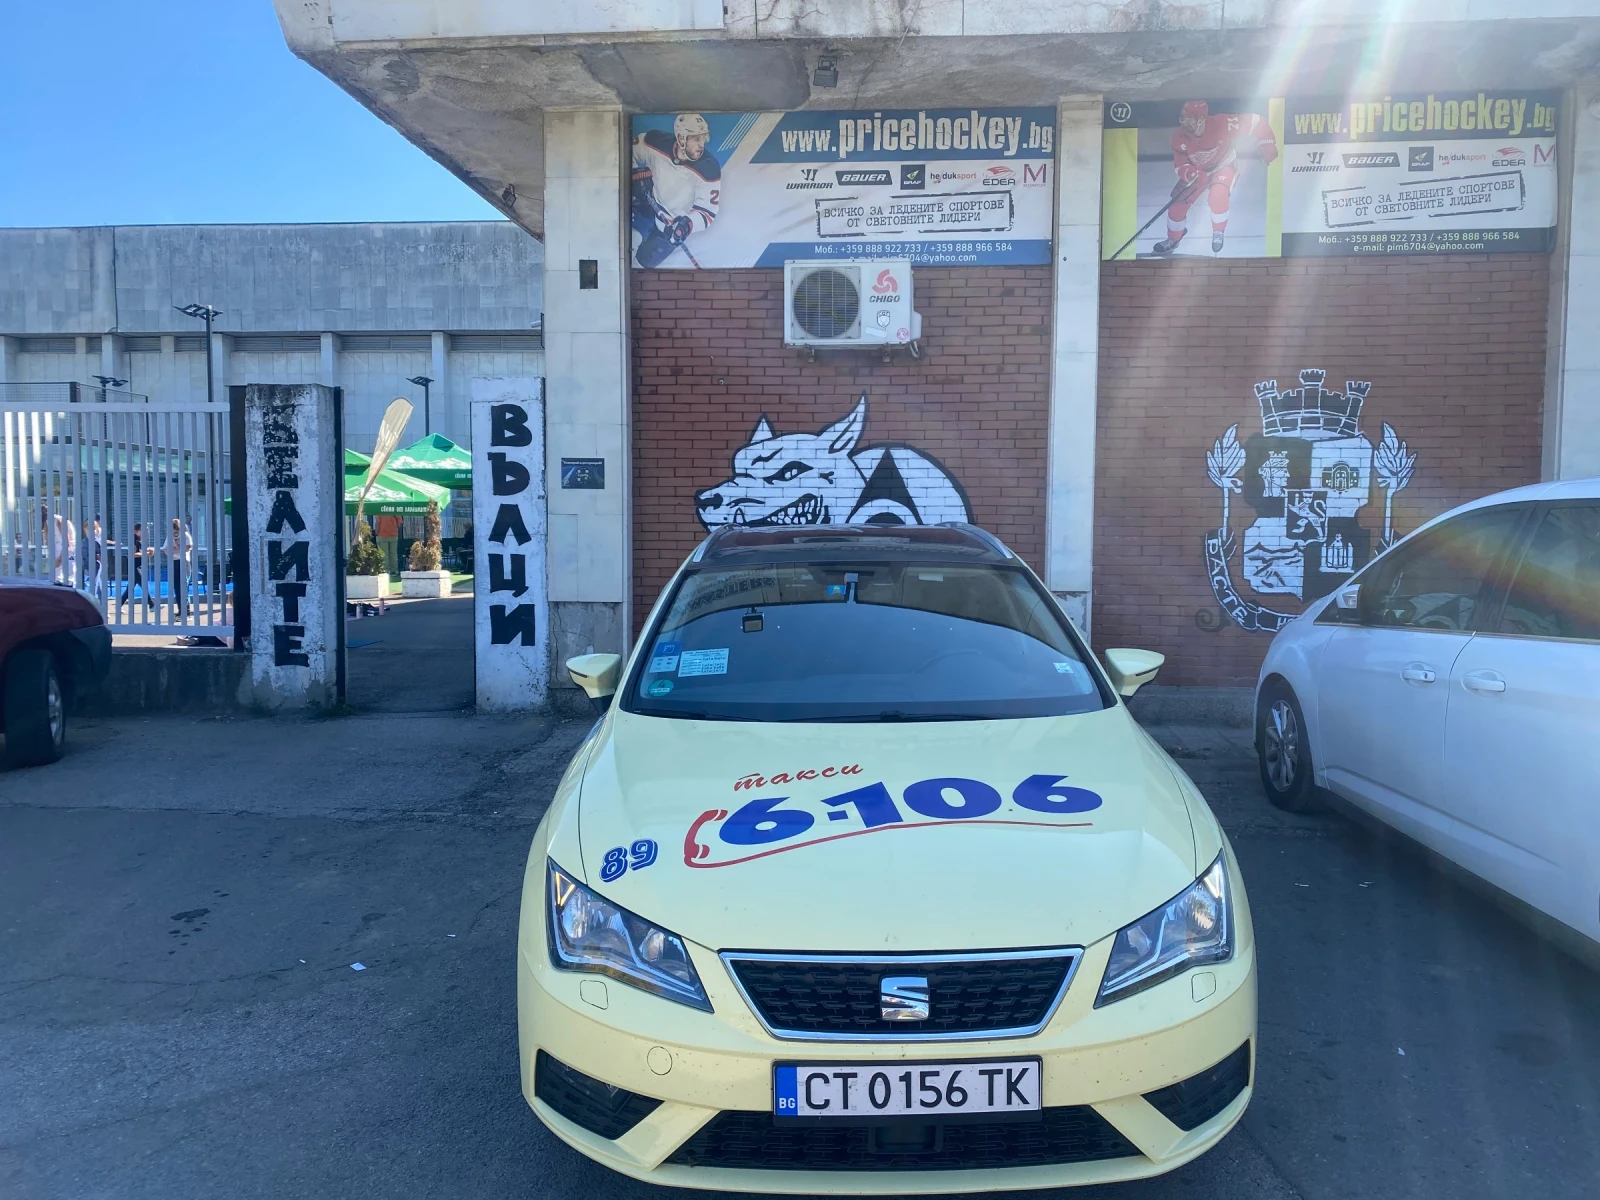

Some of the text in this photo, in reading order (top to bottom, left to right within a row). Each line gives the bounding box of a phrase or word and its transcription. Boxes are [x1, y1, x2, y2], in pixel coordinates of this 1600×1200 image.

[1294, 93, 1556, 140] www.pricehockey.bg
[782, 110, 1053, 159] www.pricehockey.bg
[1291, 165, 1340, 173] WARRIOR
[1348, 156, 1394, 165] BAUER
[786, 182, 833, 190] WARRIOR
[841, 173, 887, 182] BAUER
[1331, 179, 1515, 209] ВСИЧКО ЗА ЛЕДЕНИТЕ СПОРТОВЕ
[824, 199, 1005, 218] ВСИЧКО ЗА ЛЕДЕНИТЕ СПОРТОВЕ
[1355, 193, 1492, 217] ОТ СВЕТОВНИТЕ ЛИДЕРИ
[847, 211, 981, 228] ОТ СВЕТОВНИТЕ ЛИДЕРИ
[1345, 234, 1368, 243] +359
[1370, 233, 1388, 243] 888
[1390, 233, 1407, 242] 922
[1410, 233, 1427, 242] 733
[1436, 232, 1459, 241] +359
[1462, 232, 1479, 241] 888
[1482, 232, 1500, 240] 966
[1502, 231, 1520, 240] 584
[814, 244, 838, 254] Моб.:
[841, 244, 863, 253] +359
[865, 244, 882, 253] 888
[885, 243, 902, 252] 922
[904, 243, 921, 252] 733
[930, 243, 953, 251] +359
[956, 242, 972, 251] 888
[975, 242, 993, 251] 966
[995, 242, 1013, 250] 584
[1353, 241, 1484, 252] e-mail: pim6704@yahoo.com
[869, 295, 901, 303] CHIGO
[733, 763, 864, 793] такси
[600, 838, 658, 883] 89
[779, 1067, 1031, 1110] BG CT 0156 TK
